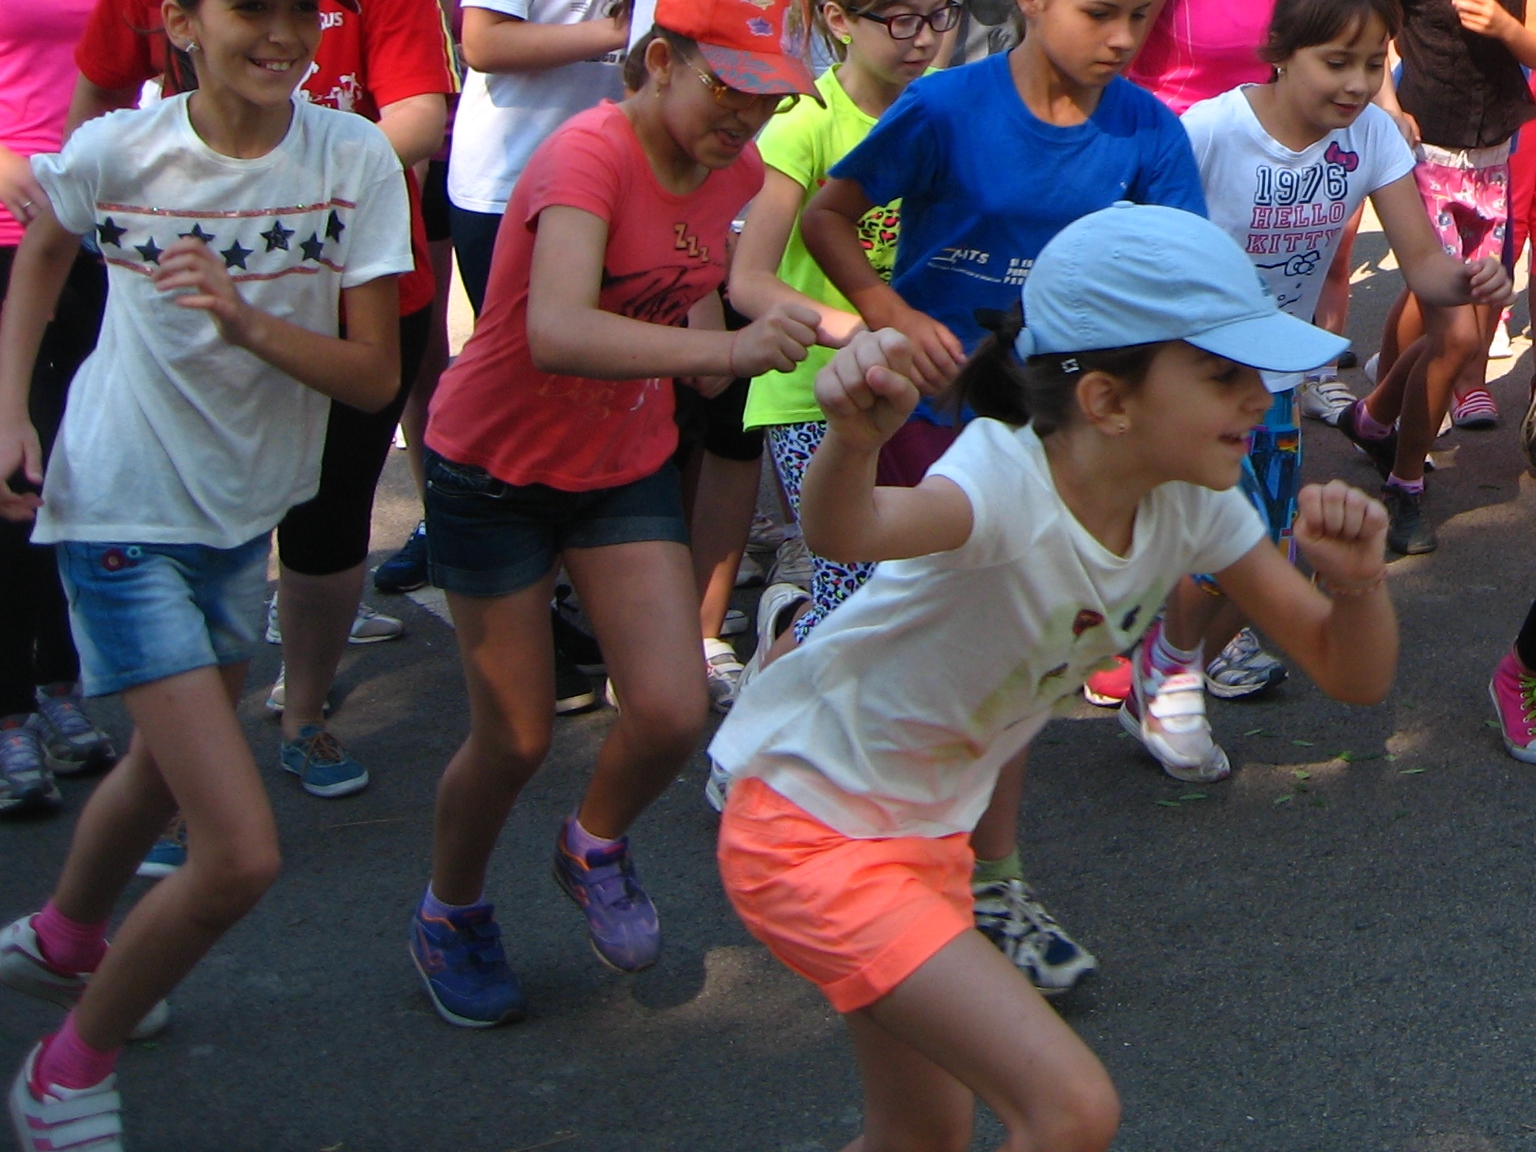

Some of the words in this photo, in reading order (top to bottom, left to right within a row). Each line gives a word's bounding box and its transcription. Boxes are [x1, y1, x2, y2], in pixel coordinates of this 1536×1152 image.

[1254, 162, 1348, 206] 1976
[1250, 201, 1346, 230] HELLO
[1245, 226, 1342, 254] KITTY
